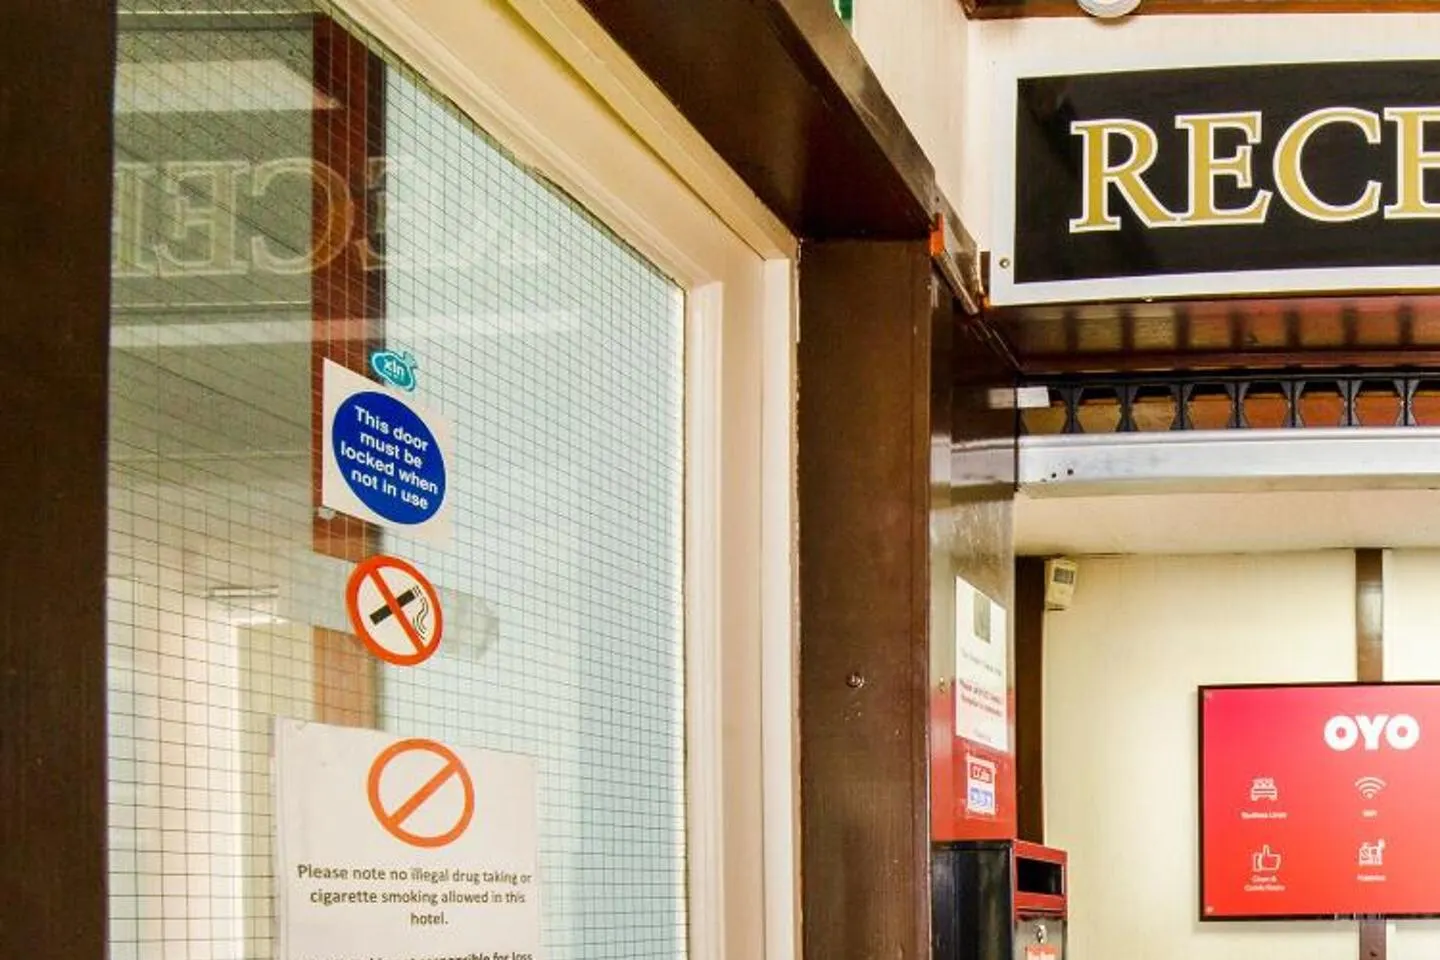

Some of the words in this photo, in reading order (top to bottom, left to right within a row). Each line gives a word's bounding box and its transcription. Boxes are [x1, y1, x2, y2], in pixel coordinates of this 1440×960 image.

[354, 405, 390, 435] This
[392, 425, 429, 452] door
[341, 440, 395, 476] locked
[398, 466, 439, 494] when
[360, 431, 400, 460] must
[404, 447, 423, 469] be
[351, 468, 378, 490] not
[382, 479, 397, 497] in
[400, 488, 429, 510] use
[1323, 713, 1420, 751] OYO
[297, 863, 349, 880] Please
[352, 867, 386, 881] note
[389, 868, 408, 881] no
[411, 866, 449, 883] illegal
[452, 867, 481, 885] drug
[482, 868, 518, 886] taking
[519, 873, 532, 883] or
[310, 888, 378, 906] cigarette
[381, 888, 439, 907] smoking
[440, 889, 489, 904] allowed
[491, 891, 503, 903] in
[505, 890, 526, 904] this
[410, 910, 449, 926] hotel.
